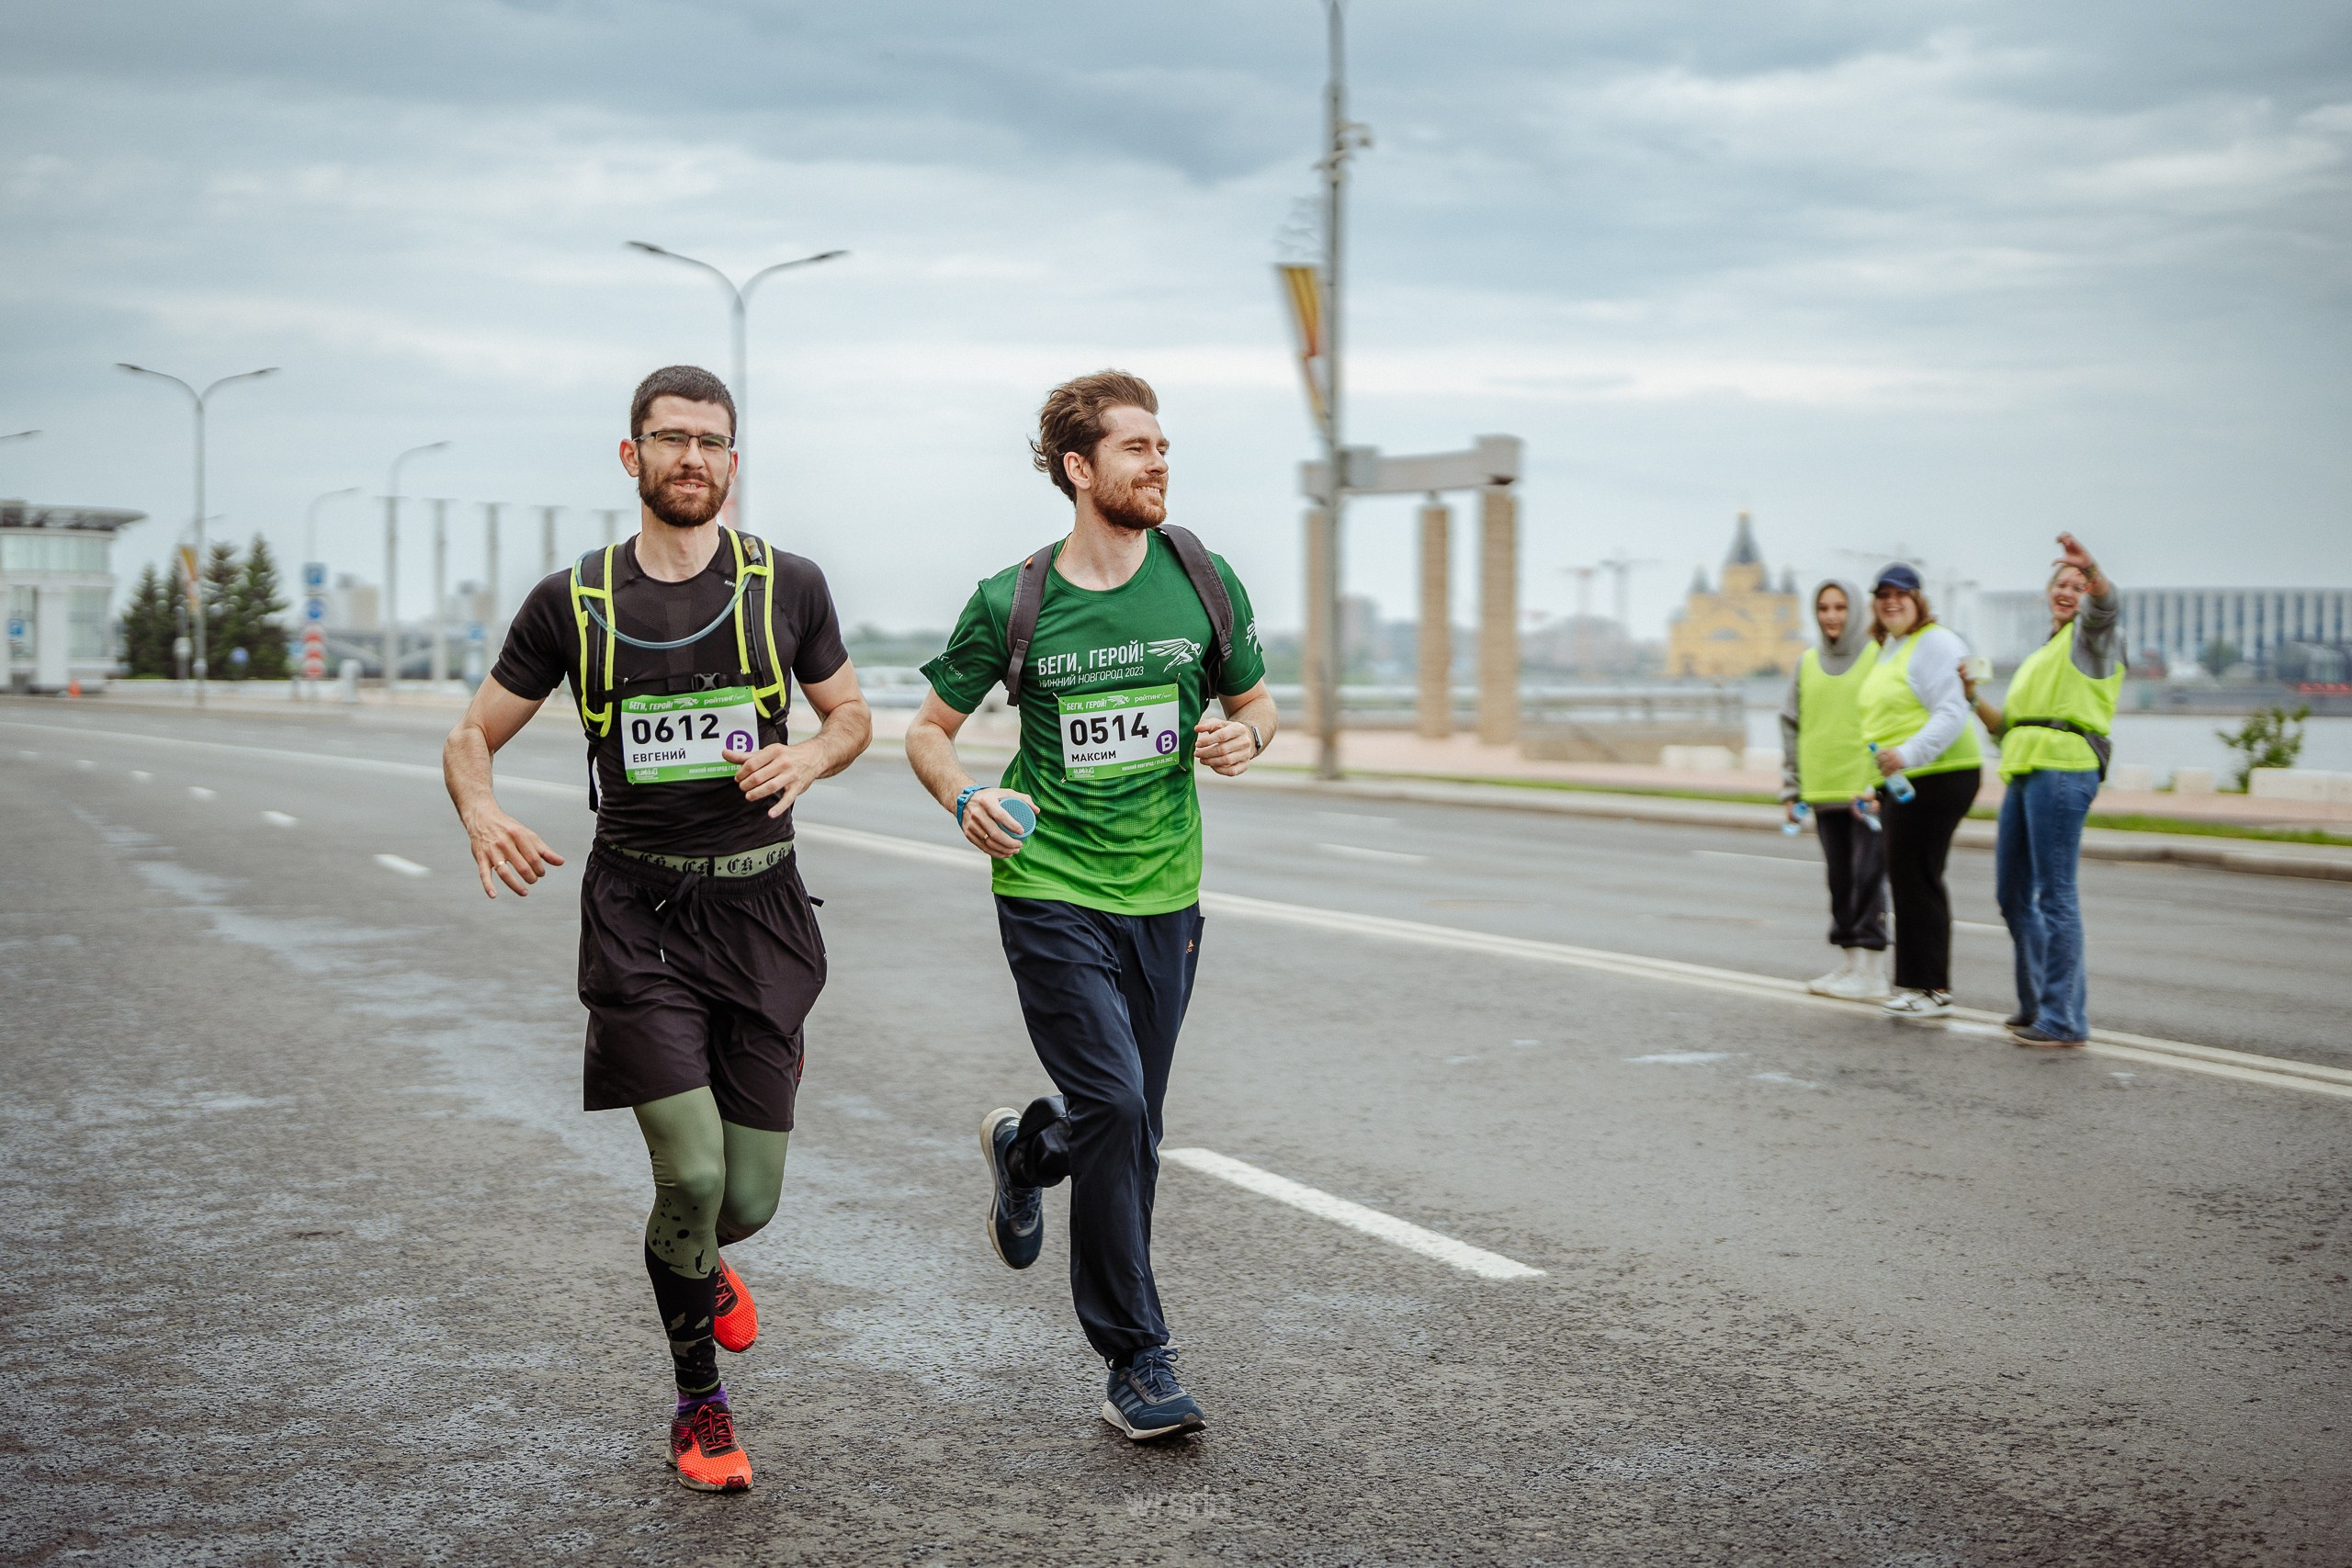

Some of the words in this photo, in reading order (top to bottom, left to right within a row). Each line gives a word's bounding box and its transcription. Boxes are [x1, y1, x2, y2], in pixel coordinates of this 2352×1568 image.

[1037, 652, 1082, 676] БЕГИ,
[1089, 639, 1145, 670] ГЕРОЙ!
[1038, 673, 1076, 688] НИЖНИЙ
[1078, 668, 1124, 684] НОВГОРОД
[1125, 666, 1145, 678] 2023
[628, 700, 648, 712] БЕГИ,
[650, 700, 673, 711] ГЕРОЙ!
[1067, 701, 1084, 711] БЕГИ,
[1085, 698, 1107, 710] ГЕРОЙ!
[631, 713, 720, 745] 0612
[1069, 712, 1149, 746] 0514
[632, 748, 686, 763] ЕВГЕНИЙ
[1071, 750, 1116, 762] МАКСИМ
